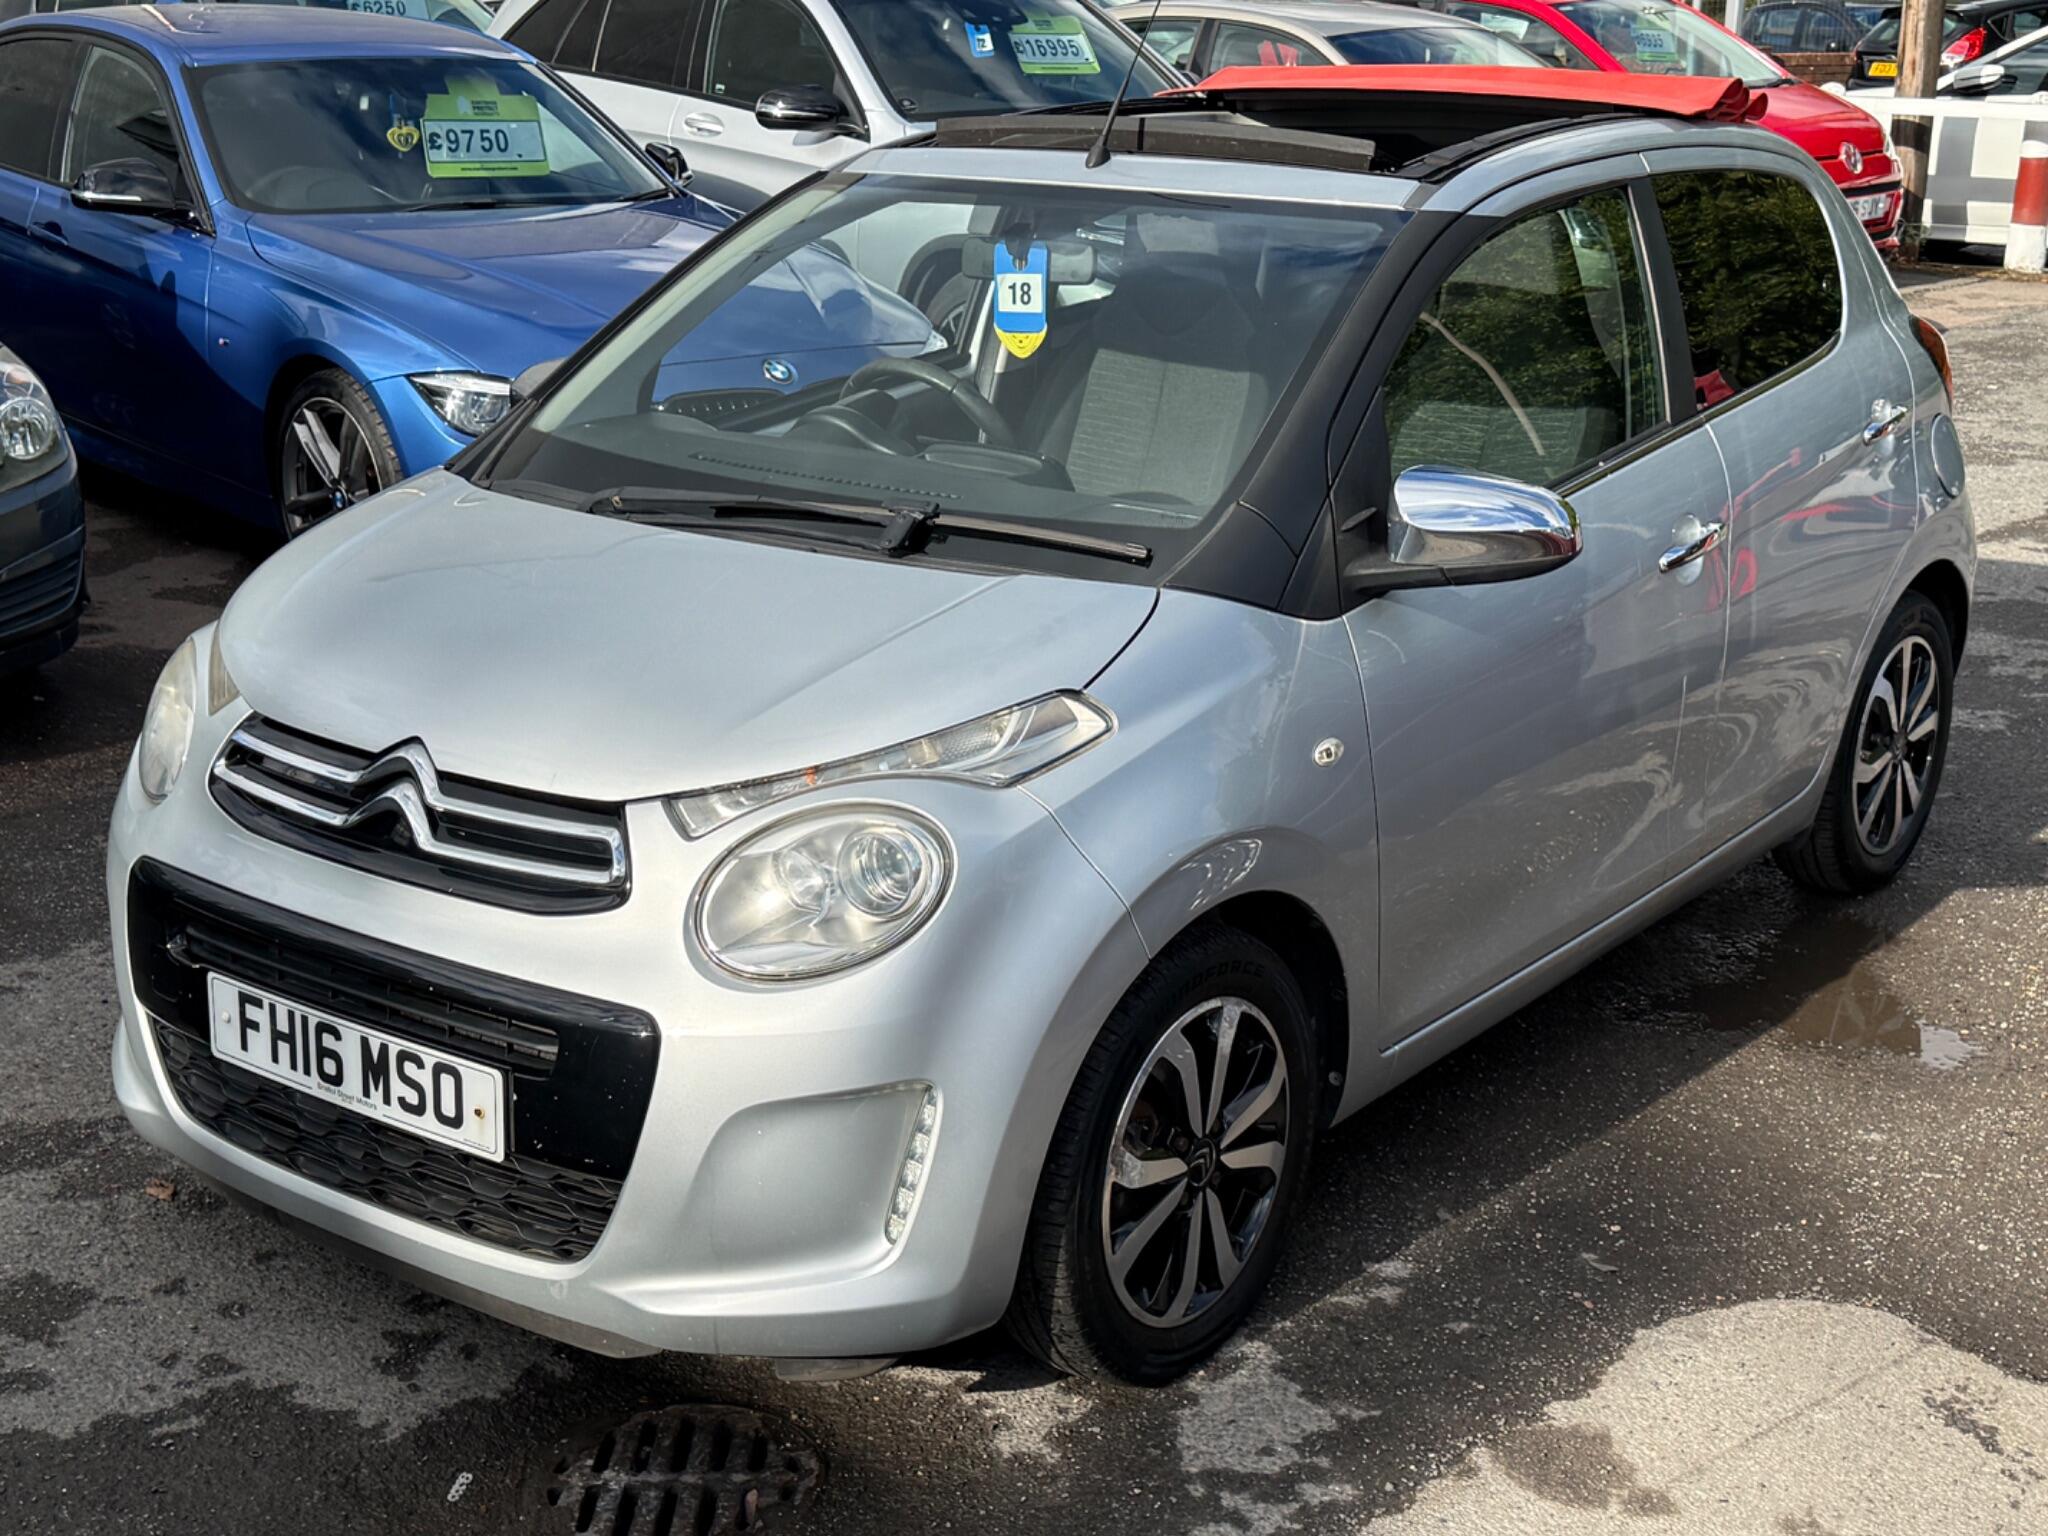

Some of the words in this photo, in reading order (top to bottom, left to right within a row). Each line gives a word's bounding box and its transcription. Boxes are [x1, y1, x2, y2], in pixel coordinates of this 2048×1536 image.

[1013, 39, 1080, 57] £16995
[428, 128, 509, 153] £9750
[1008, 282, 1031, 305] 18
[237, 990, 344, 1087] FH16
[360, 1035, 464, 1130] MSO
